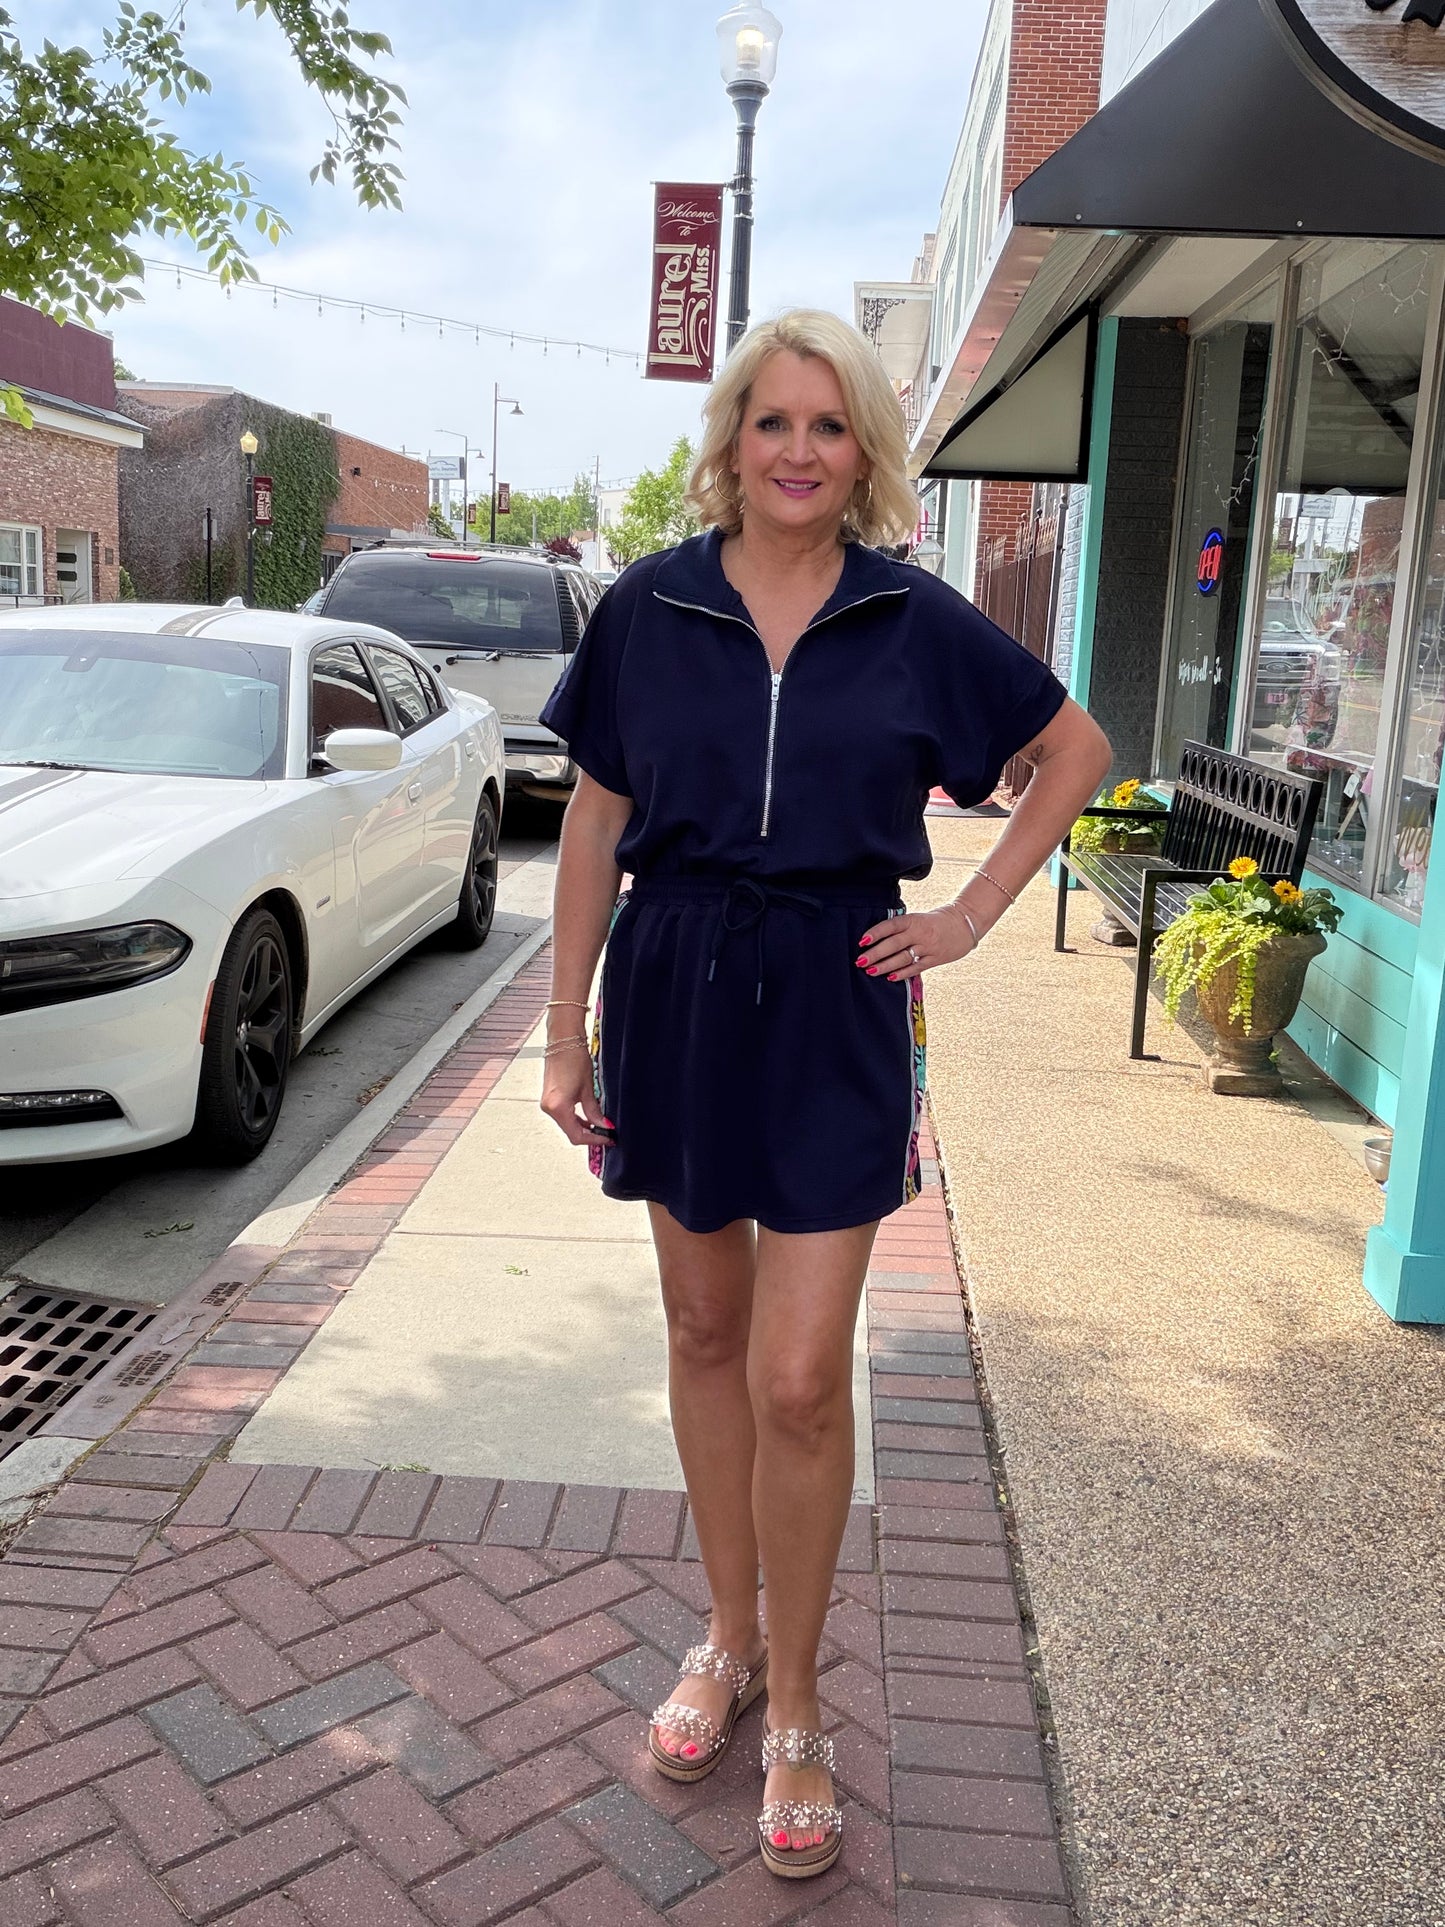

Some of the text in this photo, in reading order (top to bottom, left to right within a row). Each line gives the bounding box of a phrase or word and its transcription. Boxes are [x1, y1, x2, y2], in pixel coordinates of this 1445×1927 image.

[657, 201, 719, 223] Welcome
[678, 225, 698, 237] to
[690, 244, 713, 297] Miss.
[648, 243, 703, 368] Laurel
[1198, 544, 1222, 581] OPEN
